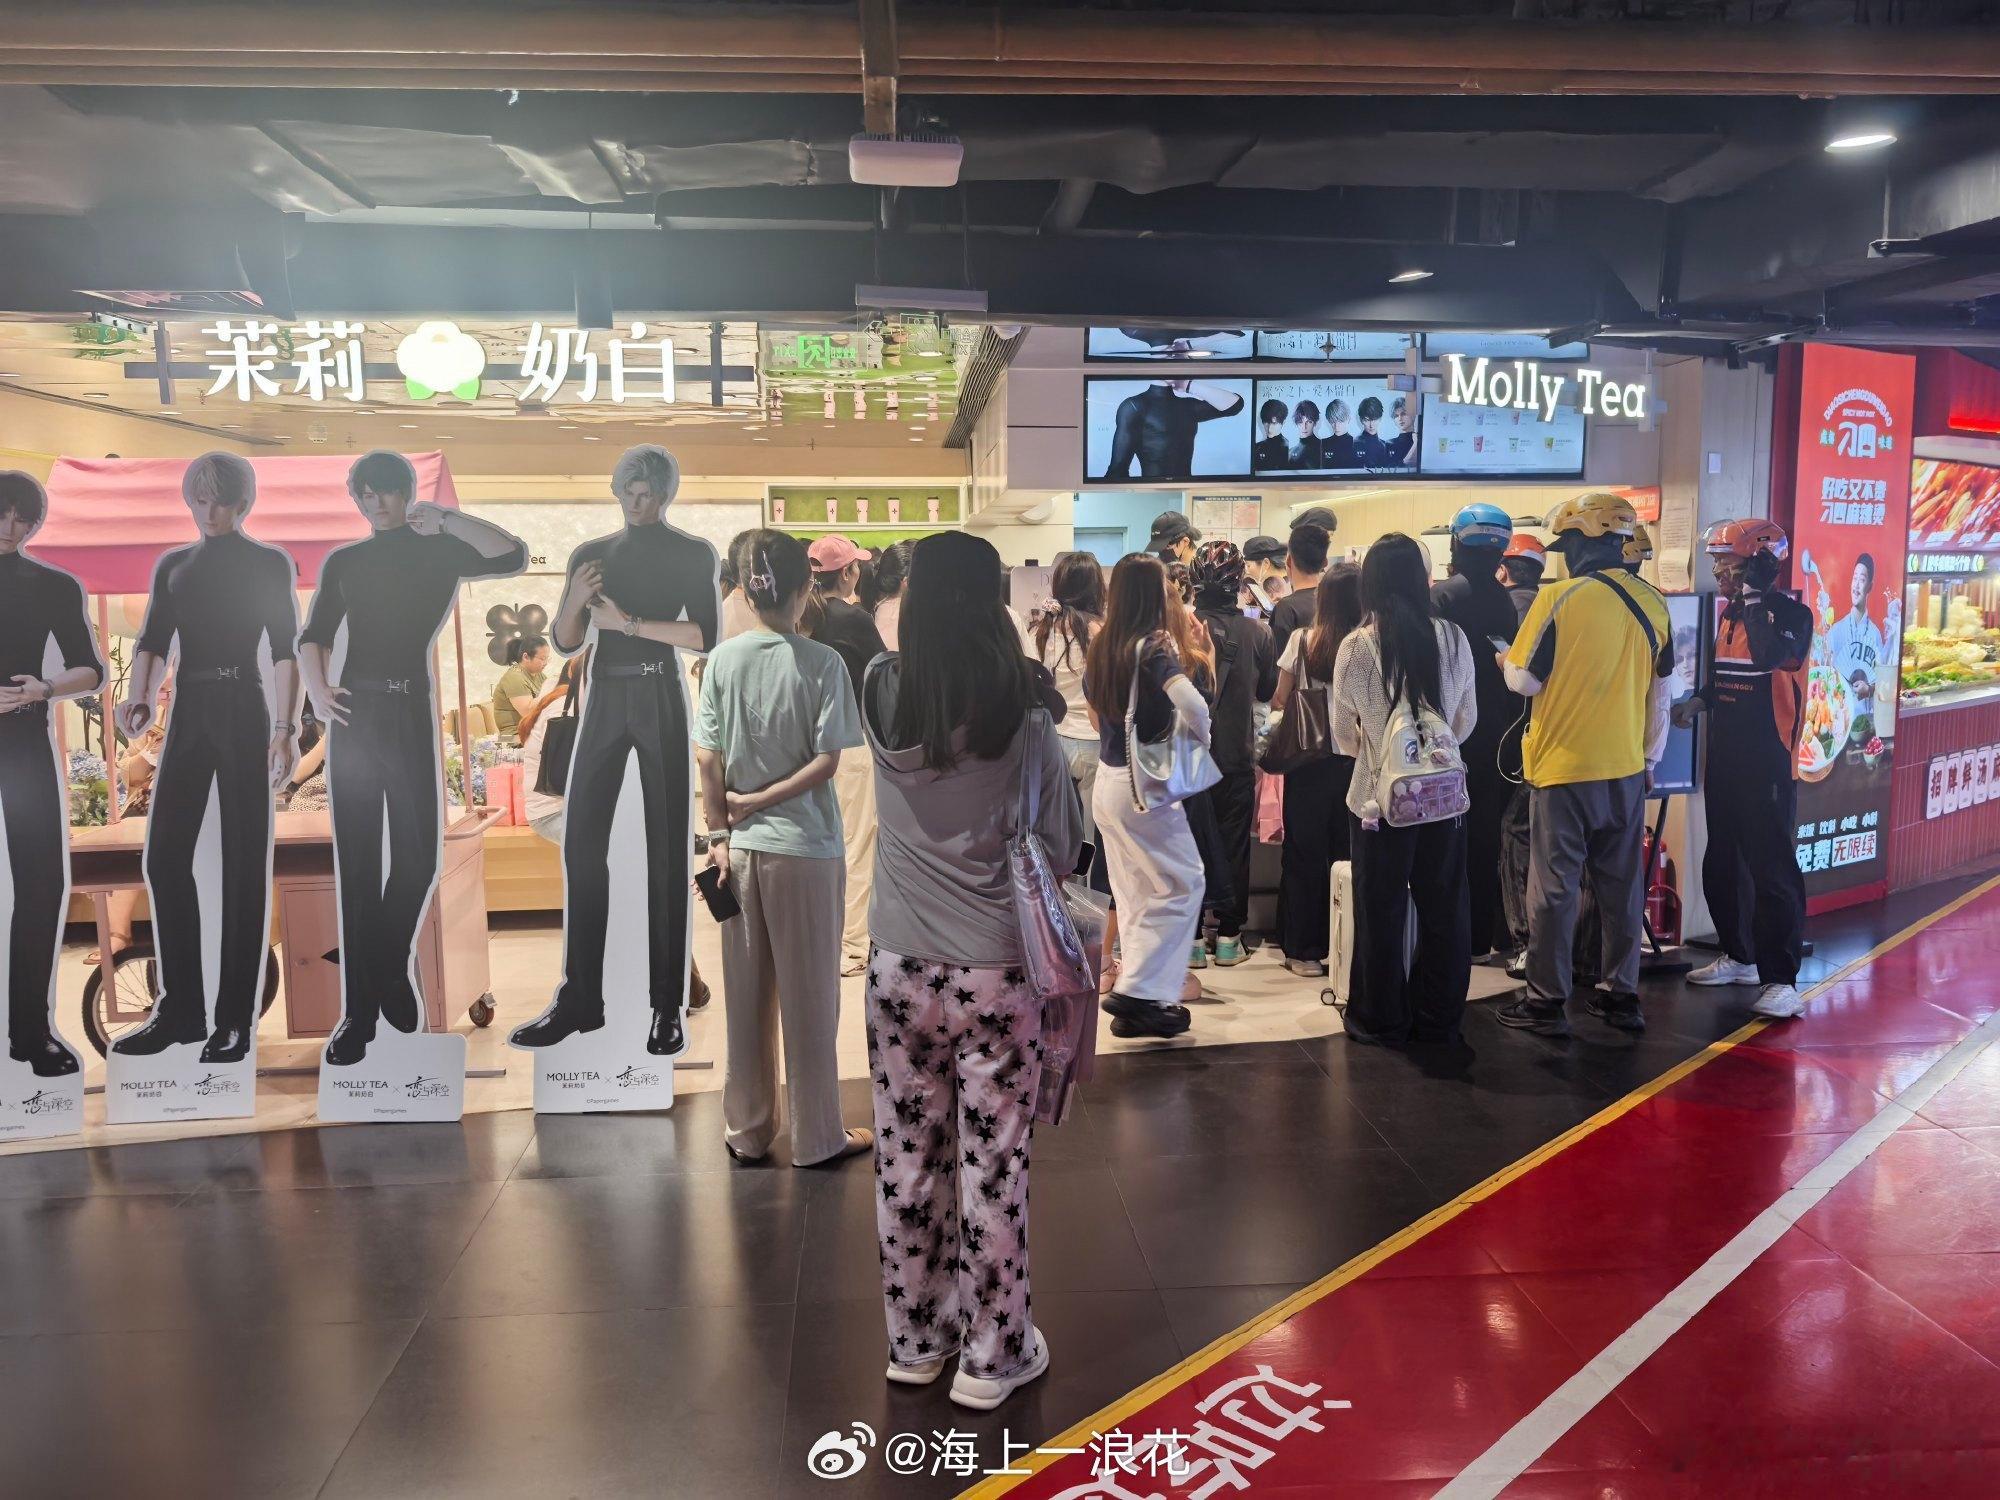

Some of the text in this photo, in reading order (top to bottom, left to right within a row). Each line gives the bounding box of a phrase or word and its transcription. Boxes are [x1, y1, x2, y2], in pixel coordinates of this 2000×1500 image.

[201, 320, 676, 403] 茉莉 奶白
[1442, 353, 1646, 422] Molly Tea
[529, 555, 547, 564] ea
[1834, 833, 1876, 863] 无限续
[546, 1071, 600, 1082] MOLLY TEA
[120, 1080, 177, 1091] MOLLY TEA
[333, 1080, 389, 1089] MOLLY TEA
